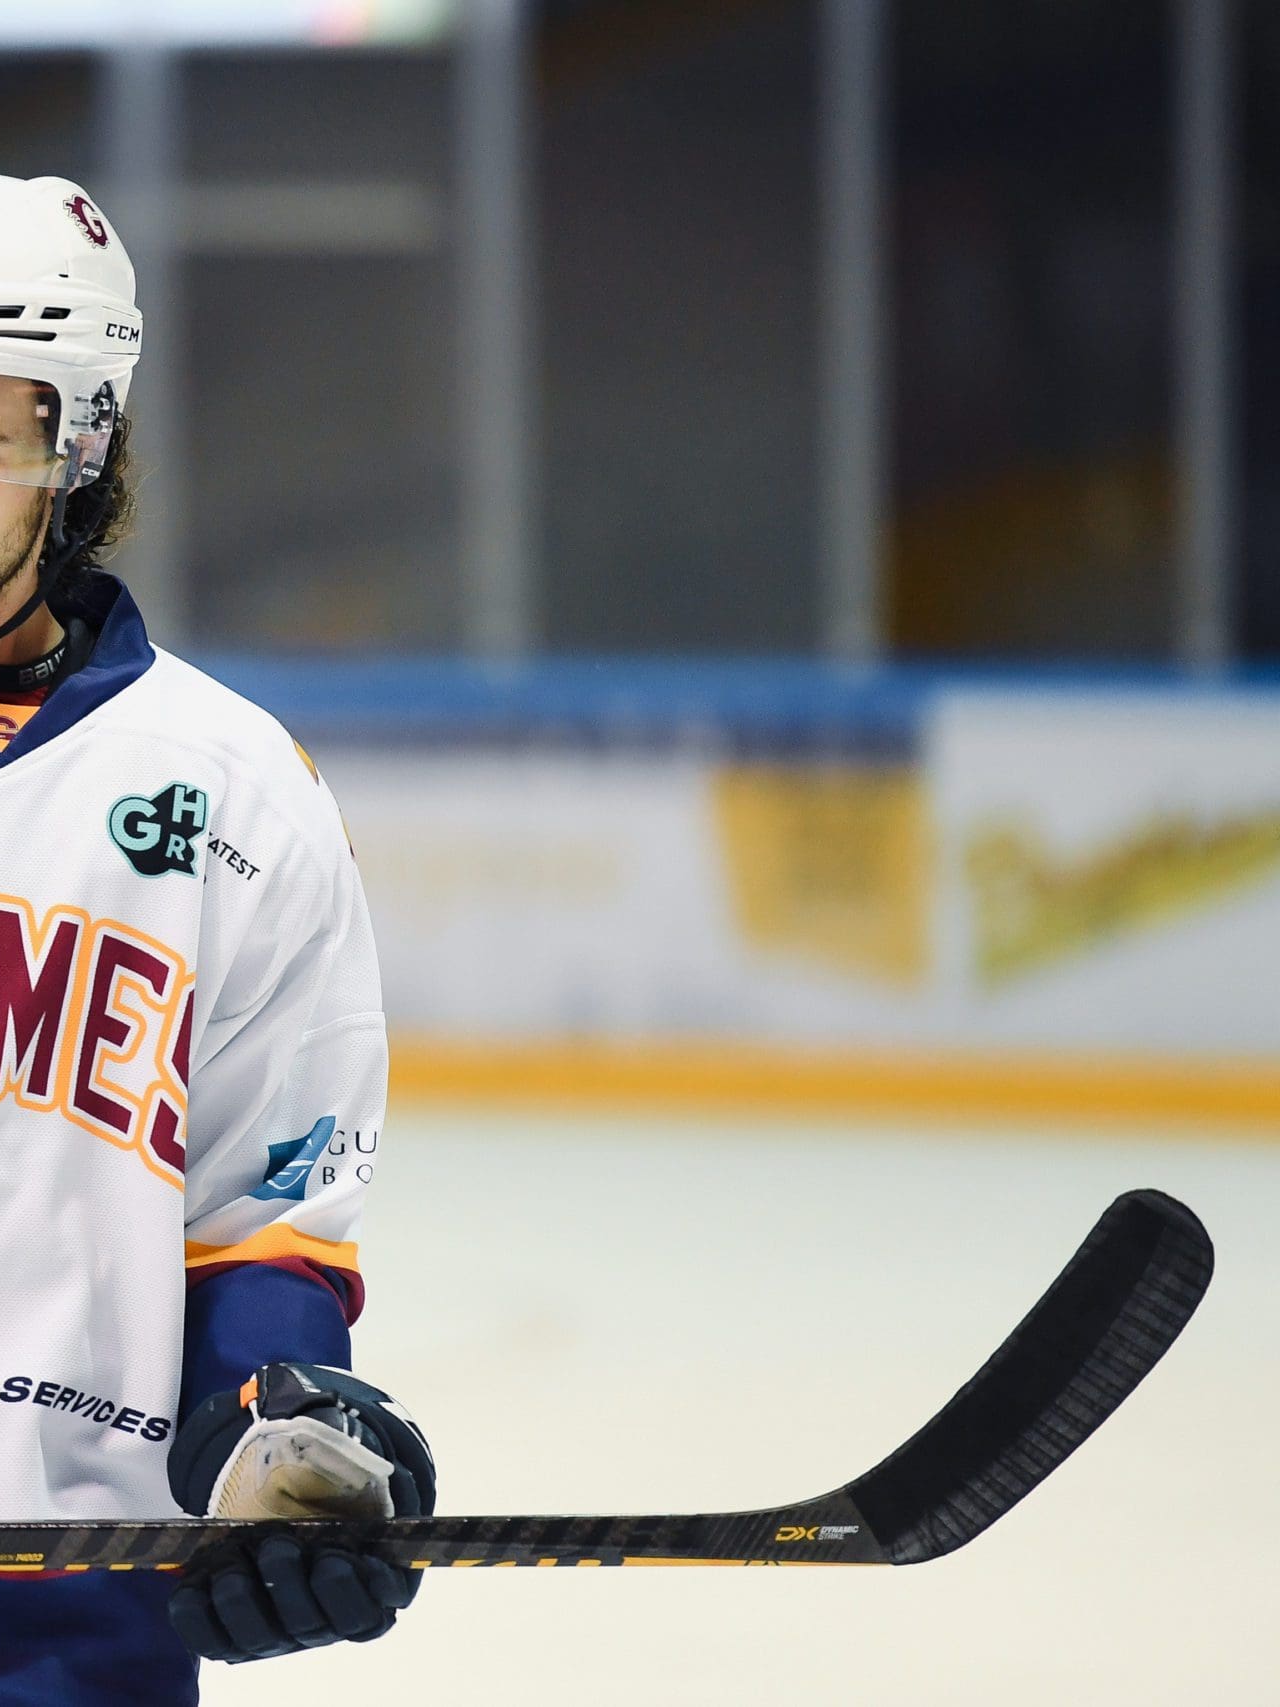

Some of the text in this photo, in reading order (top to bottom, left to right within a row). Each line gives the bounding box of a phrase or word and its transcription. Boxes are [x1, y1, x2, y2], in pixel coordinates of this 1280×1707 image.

[105, 323, 140, 343] CCM
[207, 831, 261, 881] ATEST
[328, 1130, 377, 1156] GU
[323, 1164, 374, 1185] BO
[775, 1526, 820, 1541] DX
